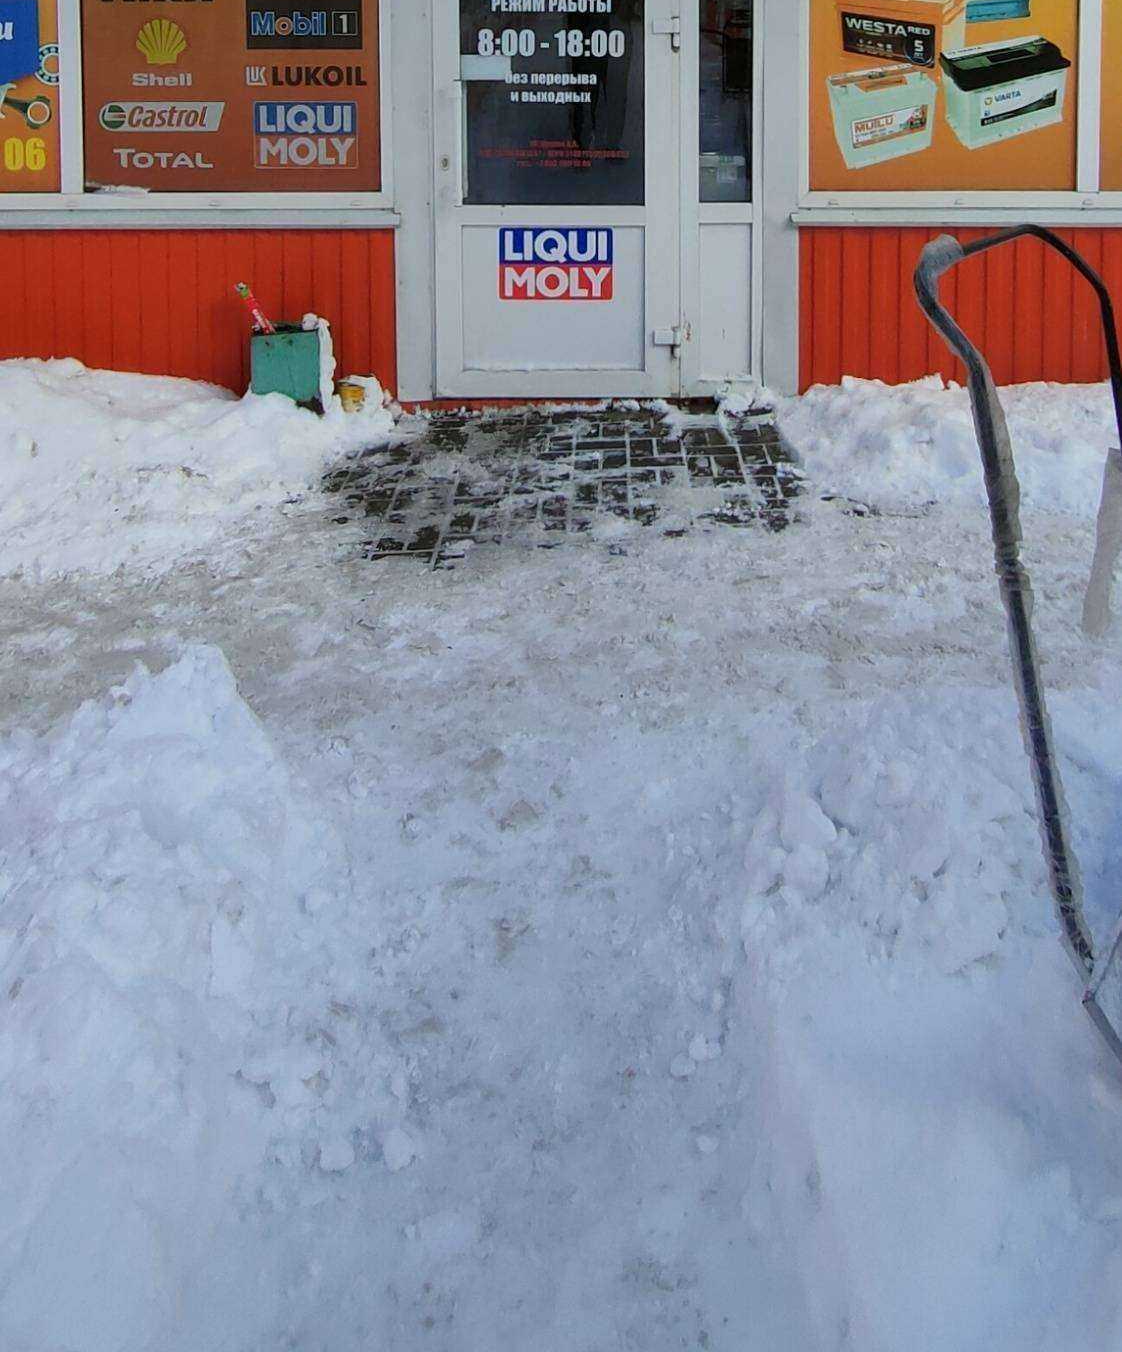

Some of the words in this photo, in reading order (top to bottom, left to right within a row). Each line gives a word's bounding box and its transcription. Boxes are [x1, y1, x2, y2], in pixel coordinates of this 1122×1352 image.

[251, 11, 327, 36] Mobil
[845, 16, 908, 38] WESTA
[907, 26, 931, 36] RED
[478, 28, 536, 57] 8:00
[554, 29, 626, 58] 18:00
[914, 39, 924, 53] 5
[131, 72, 192, 87] Shell
[271, 65, 368, 87] LUKOIL
[505, 70, 529, 85] без
[531, 72, 598, 86] перерыва
[510, 91, 519, 103] и
[521, 91, 592, 105] выходных
[994, 90, 1022, 103] VARTA
[127, 105, 208, 129] Castrol
[258, 104, 353, 134] LIQUI
[113, 148, 214, 170] TOTAL
[258, 136, 356, 166] MOLY
[504, 229, 608, 264] LIQUI
[504, 266, 612, 298] MOLY
